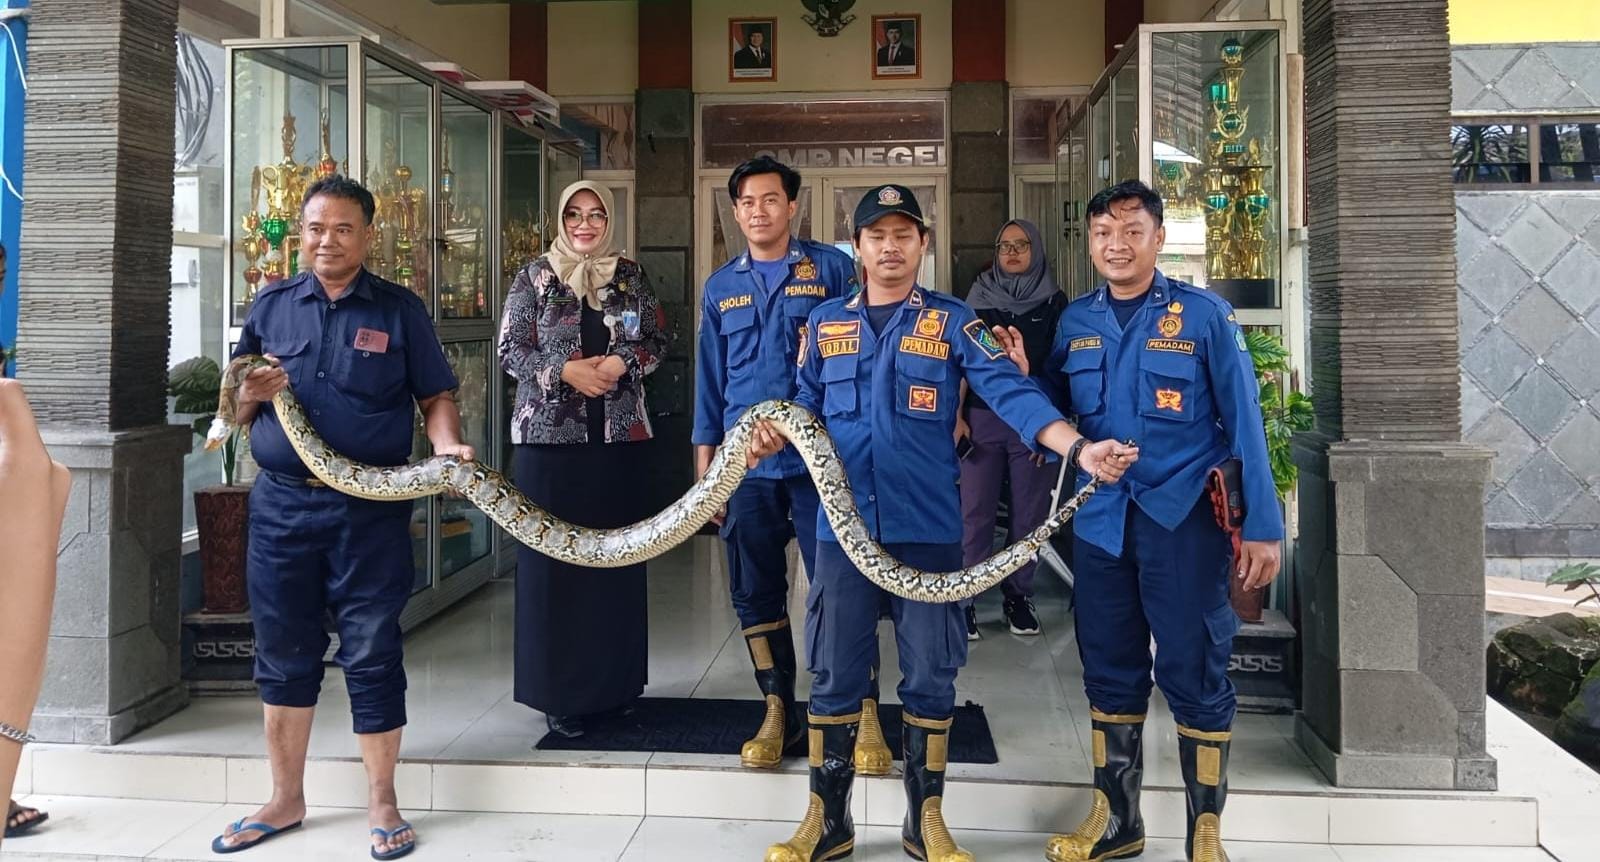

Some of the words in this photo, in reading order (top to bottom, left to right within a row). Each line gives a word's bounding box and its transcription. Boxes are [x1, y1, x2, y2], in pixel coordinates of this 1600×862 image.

[784, 285, 826, 297] PEMADAM
[719, 295, 752, 312] SHOLEH
[822, 340, 855, 355] IQBAL
[903, 338, 947, 357] PEMADAM
[1148, 340, 1192, 352] PEMADAM
